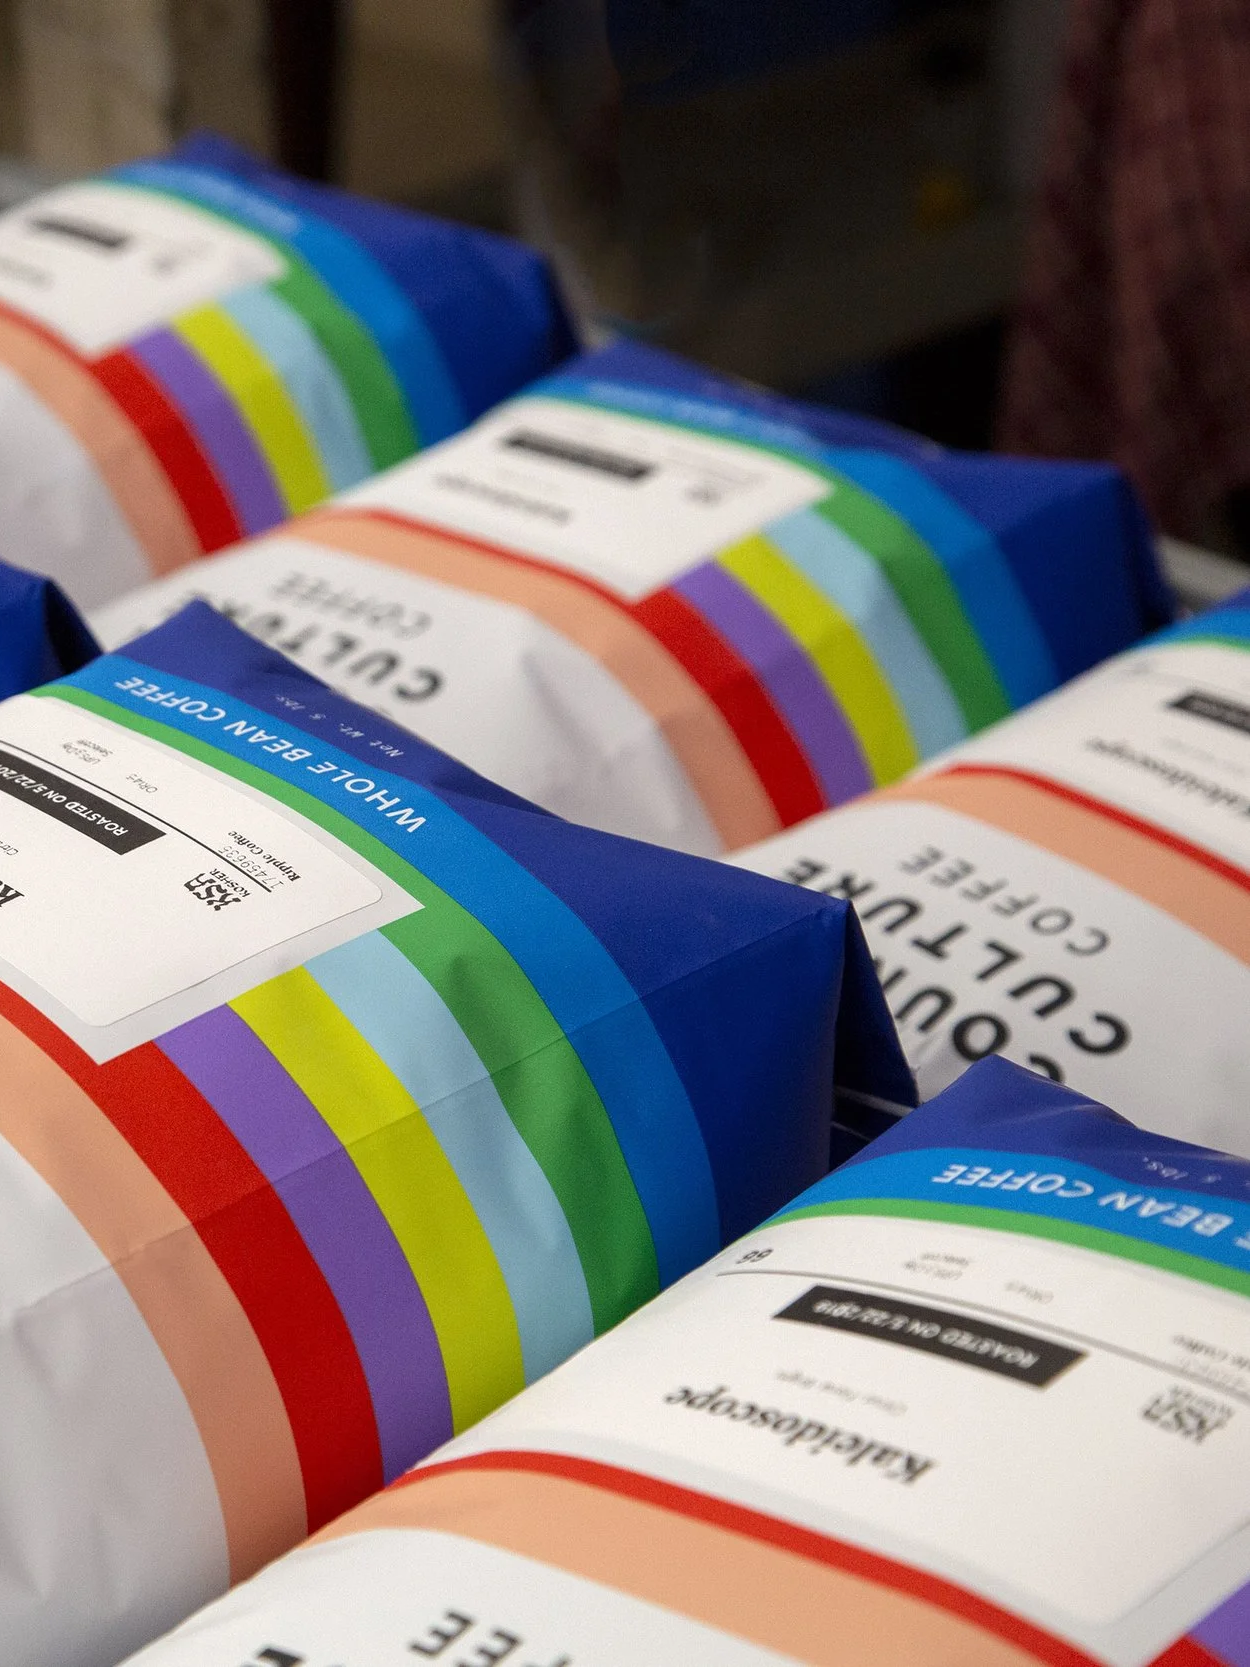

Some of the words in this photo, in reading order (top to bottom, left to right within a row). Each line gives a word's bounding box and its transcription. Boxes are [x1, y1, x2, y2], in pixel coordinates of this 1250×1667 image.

[113, 676, 226, 723] COFFEE
[223, 719, 313, 763] BEAN
[370, 740, 405, 758] Net
[42, 789, 68, 804] ON
[307, 760, 427, 834] WHOLE
[64, 800, 130, 838] ROASTED
[227, 830, 265, 856] Coffee
[209, 867, 252, 898] KOSHER
[262, 853, 302, 883] Ripple
[899, 844, 1111, 958] COFFEE
[932, 1163, 1095, 1198] COFFEE
[1098, 1191, 1235, 1238] BEAN
[904, 1317, 943, 1339] ON
[938, 1326, 1041, 1370] ROASTED
[662, 1382, 936, 1488] Kaleidoscope
